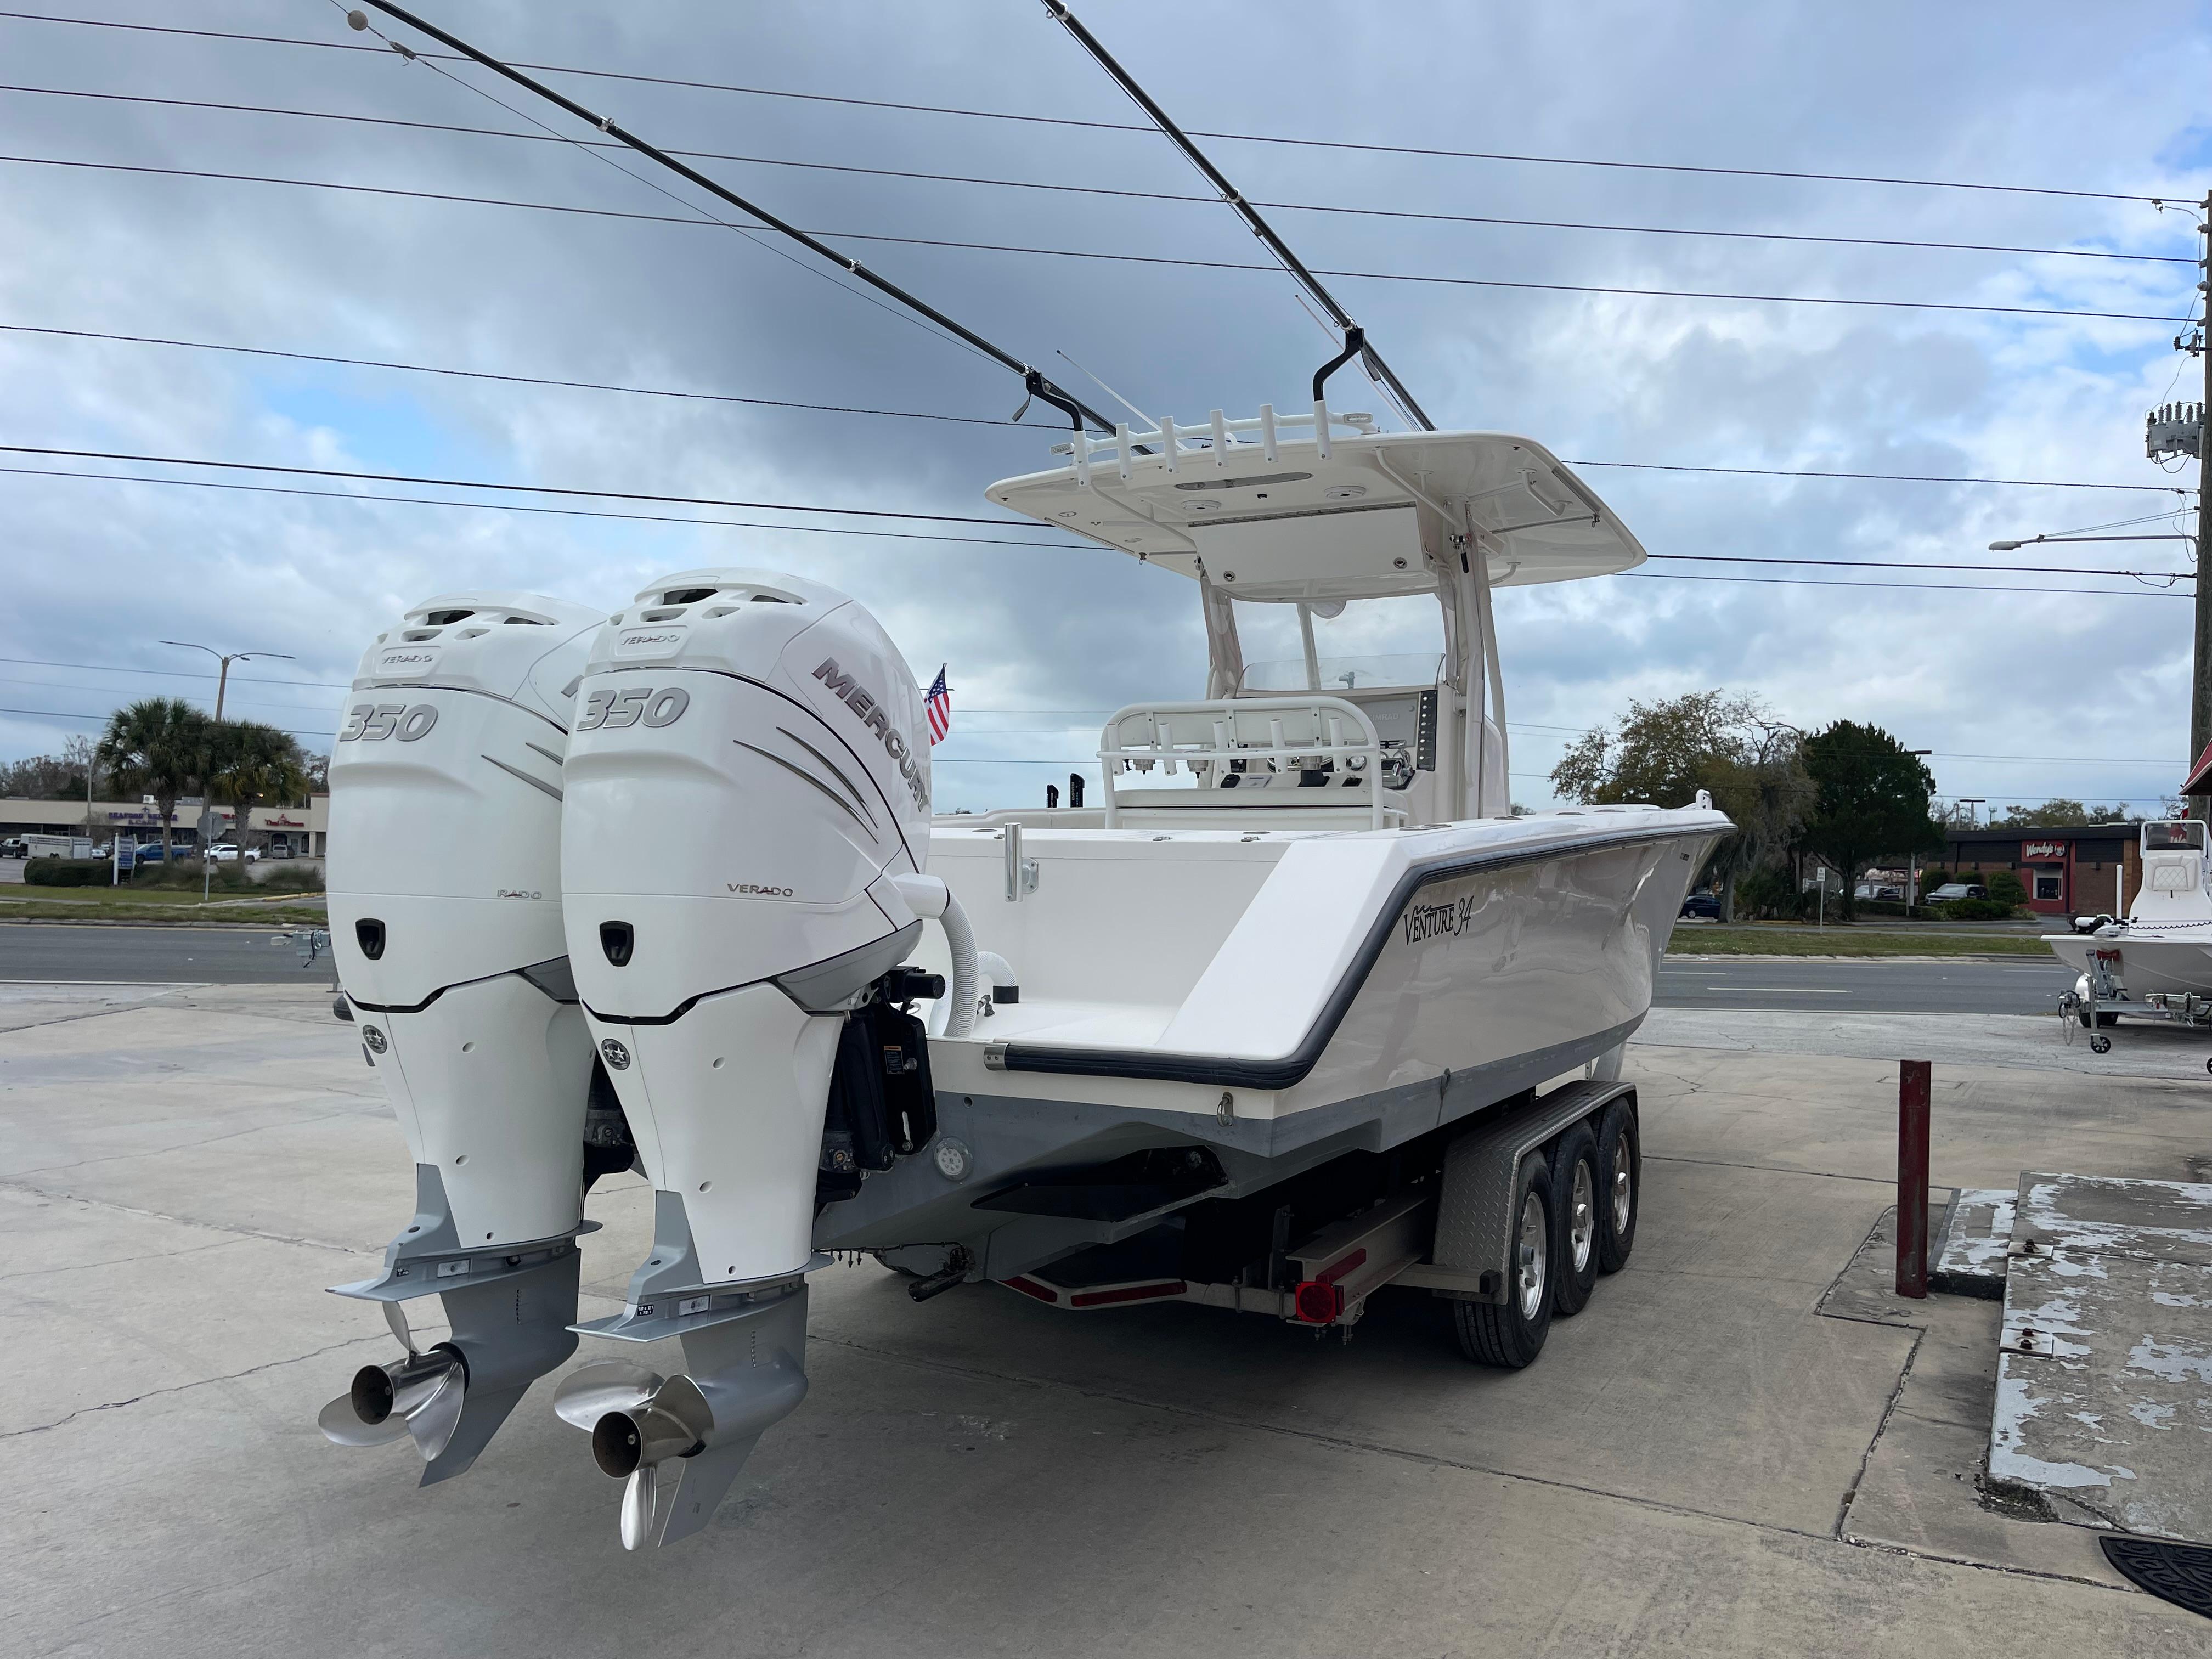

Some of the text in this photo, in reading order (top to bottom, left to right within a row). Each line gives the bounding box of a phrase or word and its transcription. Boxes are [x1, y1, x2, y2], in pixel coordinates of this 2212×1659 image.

[621, 635, 680, 645] VERADO
[382, 654, 433, 664] VERADO
[577, 687, 690, 731] 350
[339, 704, 438, 742] 350
[811, 656, 929, 812] MERCURY
[2026, 841, 2054, 857] Wendy's
[727, 883, 793, 897] VERADO
[1404, 895, 1474, 946] VENTURE 34
